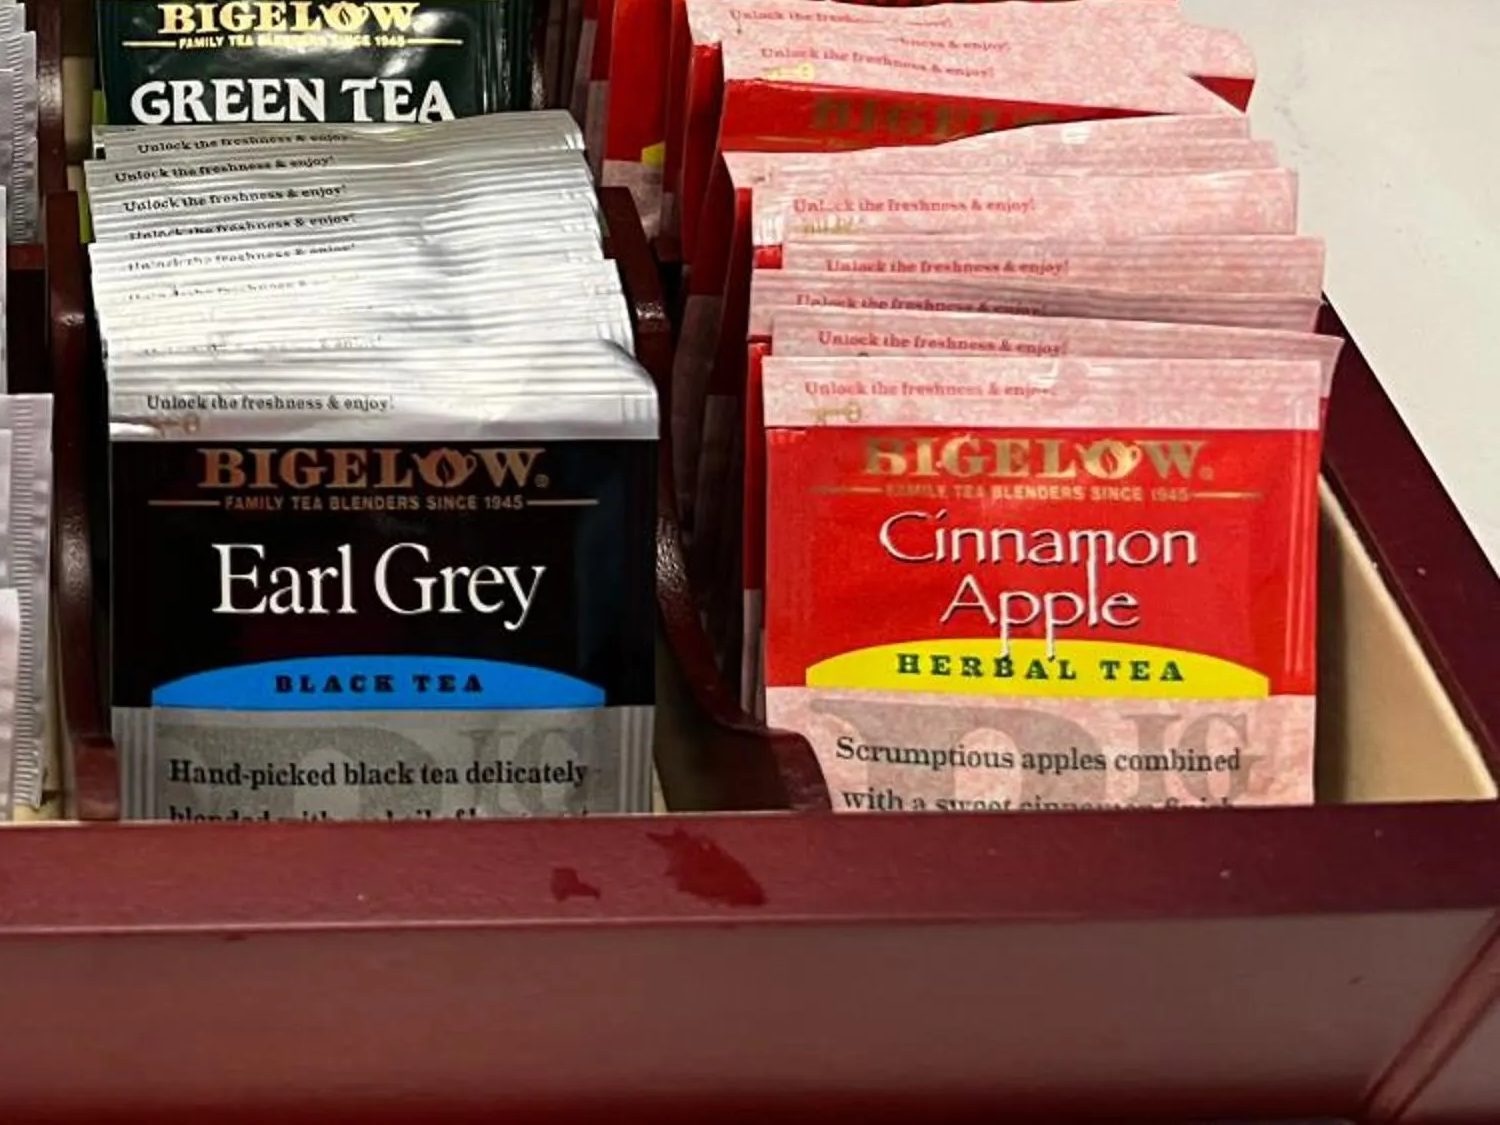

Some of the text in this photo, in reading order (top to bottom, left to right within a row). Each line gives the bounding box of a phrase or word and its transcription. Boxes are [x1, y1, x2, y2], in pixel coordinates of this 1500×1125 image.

[158, 0, 419, 34] BIGELOW
[823, 50, 849, 61] the
[131, 77, 456, 125] GREEN TEA
[137, 141, 191, 154] Unlock
[195, 139, 217, 149] the
[115, 169, 168, 183] Unlock
[172, 166, 198, 176] the
[199, 161, 271, 175] freshness
[123, 194, 180, 212] Unlock
[183, 196, 207, 207] the
[209, 190, 284, 204] freshness
[859, 199, 884, 212] the
[888, 199, 967, 212] freshness
[986, 199, 1035, 213] enjoy!
[890, 260, 917, 273] the
[921, 260, 1000, 273] freshness
[1019, 260, 1069, 276] enjoy!
[818, 331, 878, 346] Unlock
[883, 333, 910, 347] the
[914, 334, 994, 351] freshness
[1016, 341, 1067, 357] enjoy!
[804, 381, 867, 396] Unlock
[871, 382, 898, 396] the
[902, 382, 983, 396] freshness
[147, 394, 395, 412] Unlock the freshness & enjoy!
[196, 447, 546, 489] BIGELOW
[864, 434, 1207, 480] BIGELOW
[225, 495, 524, 510] FAMILY TEA BLENDERS SINCE 1945
[954, 485, 986, 499] TEA
[991, 484, 1084, 500] BLENDERS
[1090, 485, 1143, 501] SINCE
[879, 508, 1198, 566] Cinnamon
[211, 542, 546, 632] Earl Grey
[940, 575, 1141, 661] Apple
[897, 654, 1185, 682] HERBAL TEA
[275, 674, 483, 694] BLACK TEA
[835, 736, 1241, 774] Scrumptious apples combined
[168, 758, 588, 790] Hand-picked black tea delicately
[842, 787, 926, 811] with a
